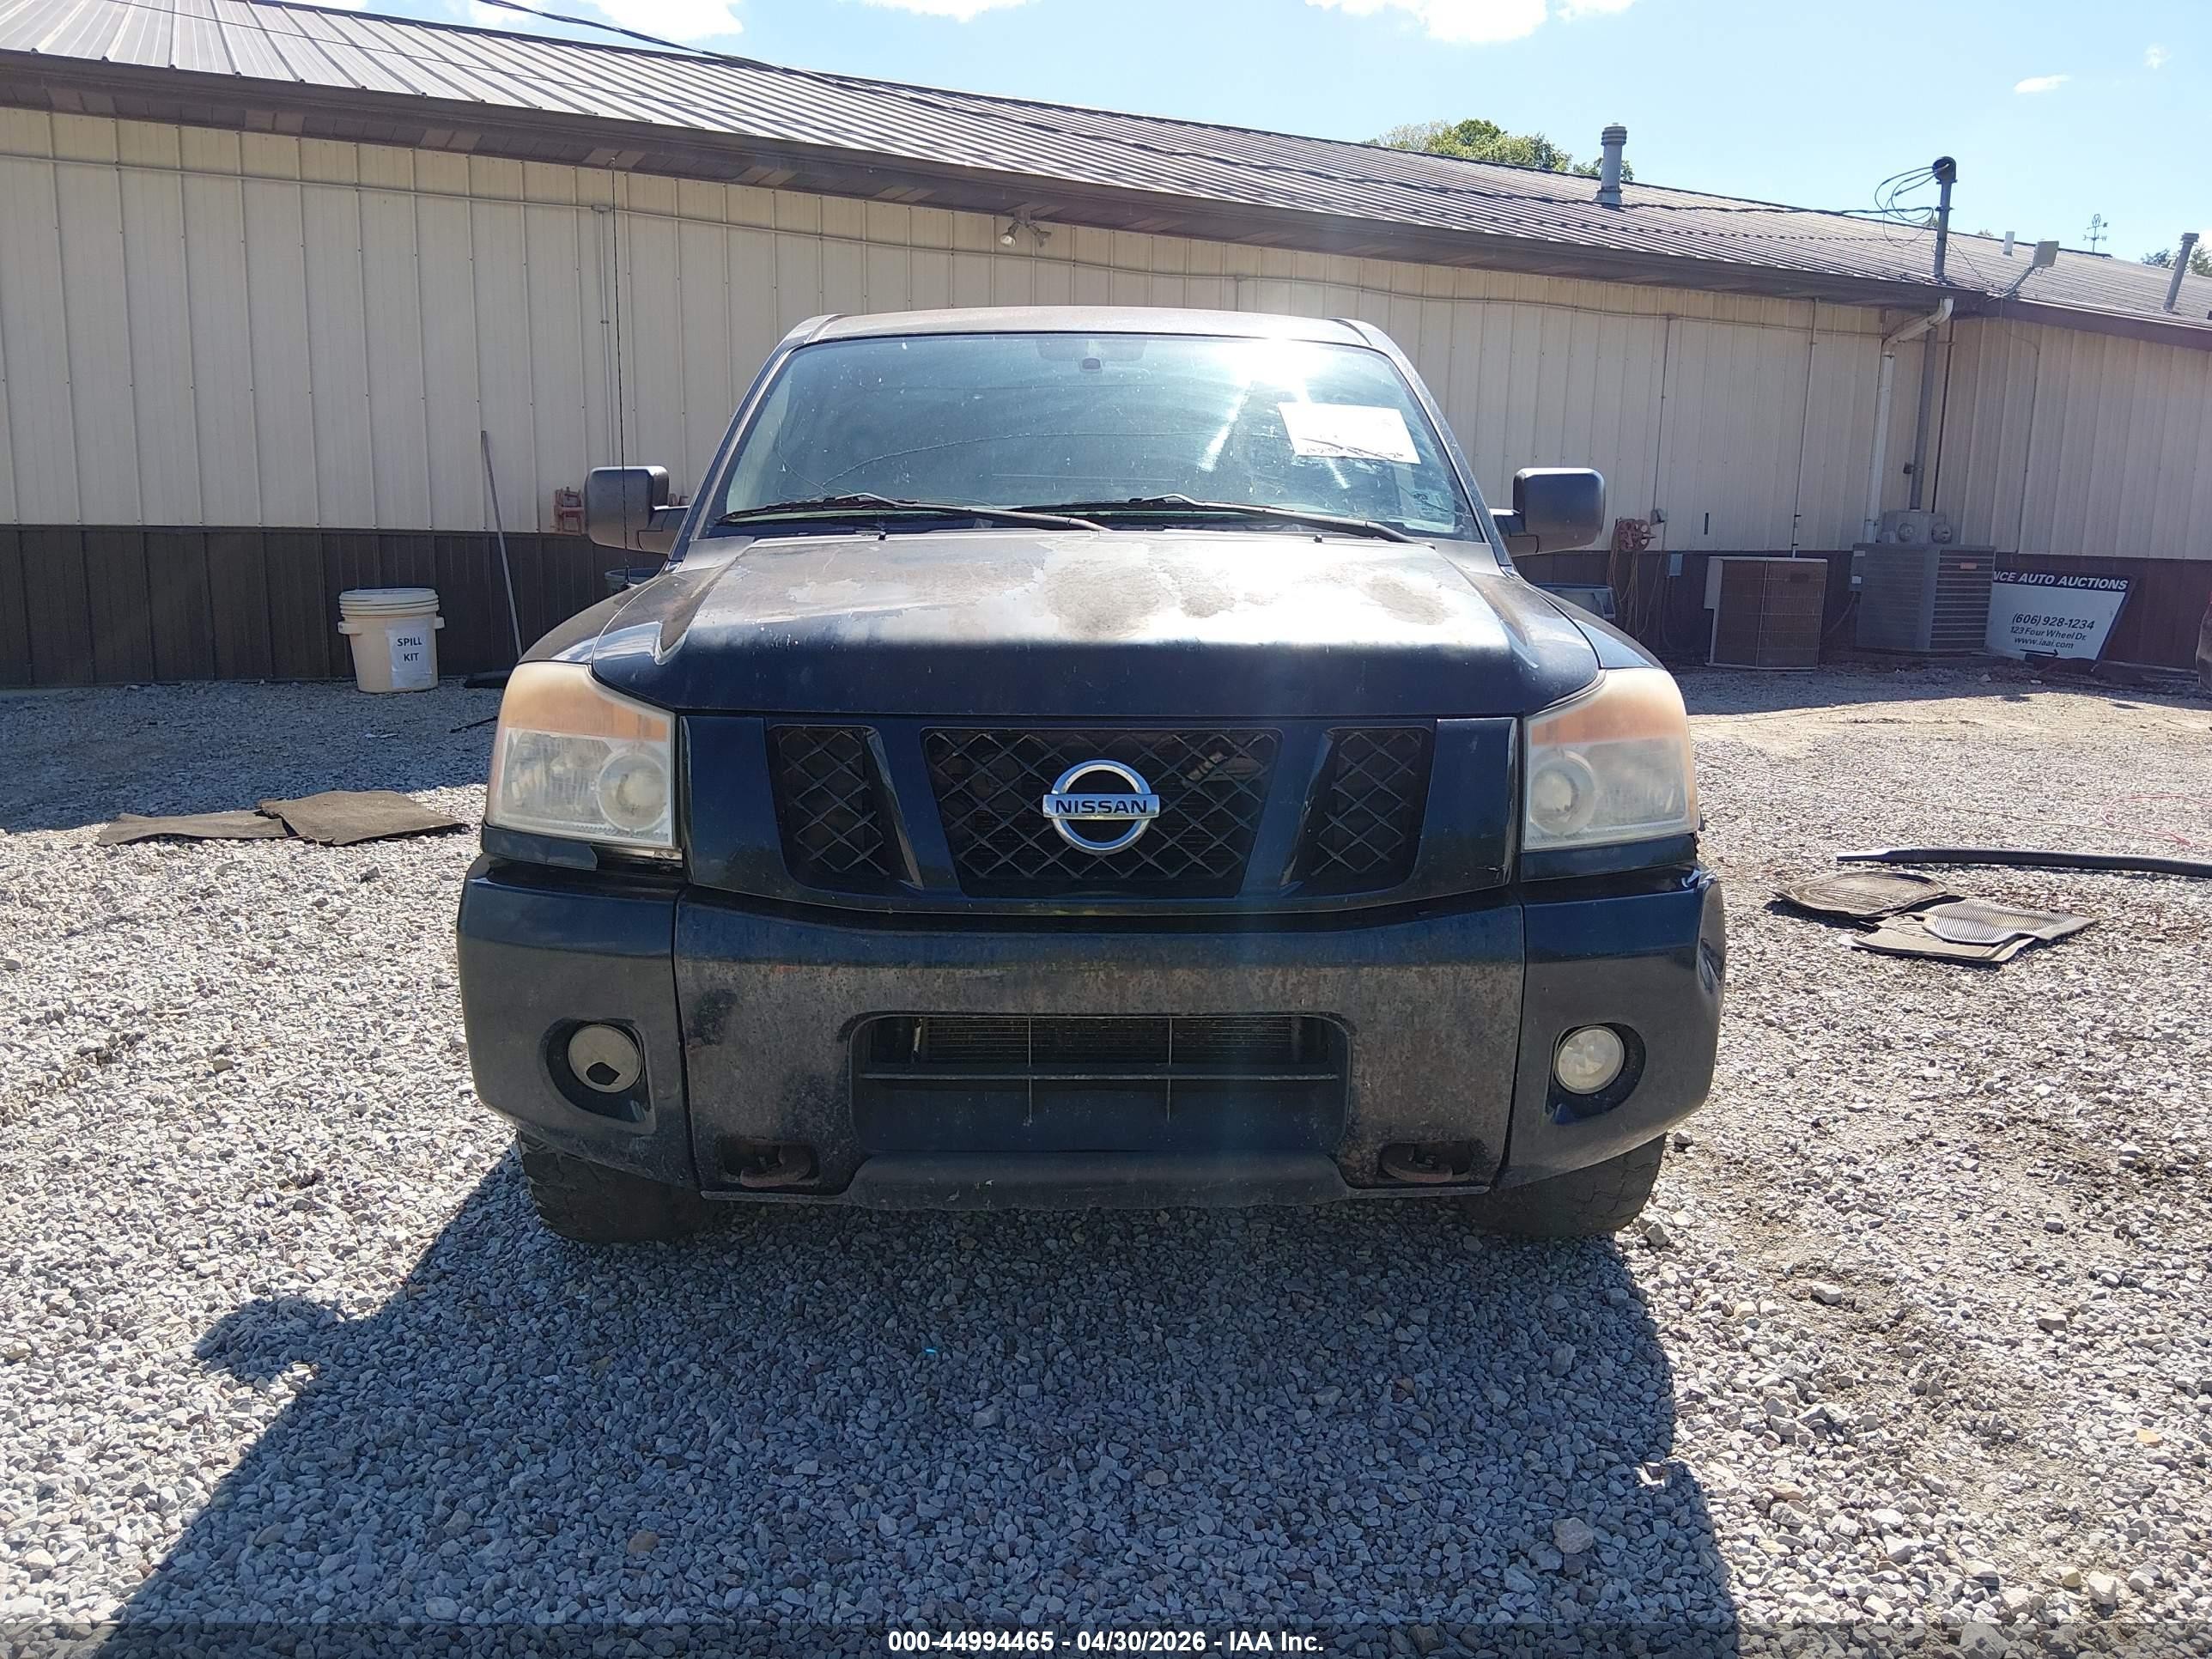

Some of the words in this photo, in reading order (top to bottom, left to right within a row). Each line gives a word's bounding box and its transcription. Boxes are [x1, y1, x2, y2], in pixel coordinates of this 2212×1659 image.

[2018, 573, 2055, 584] AUTO
[2057, 575, 2128, 590] AUCTIONS
[2012, 612, 2042, 626] (606)
[2043, 616, 2095, 629] 928-1234
[2010, 626, 2025, 635] 123
[2025, 627, 2045, 636] Four
[2046, 629, 2075, 639] Wheel
[397, 637, 422, 647] SPILL
[2014, 637, 2074, 649] www.iaai.com
[404, 653, 419, 662] KIT
[1055, 799, 1147, 814] NISSAN
